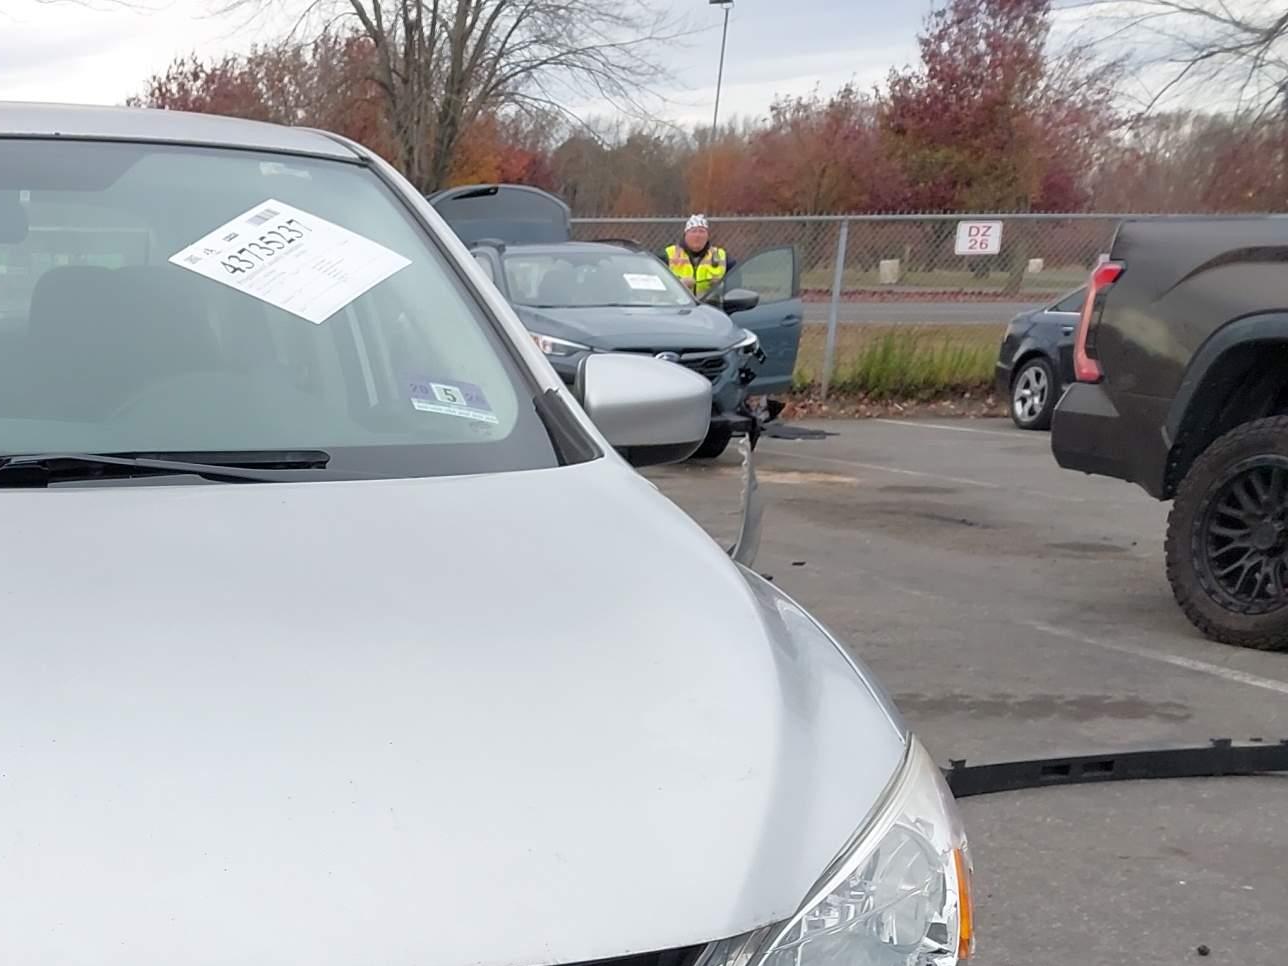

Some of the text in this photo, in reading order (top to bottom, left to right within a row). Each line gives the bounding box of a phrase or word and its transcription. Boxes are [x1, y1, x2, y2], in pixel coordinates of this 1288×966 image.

[968, 225, 993, 237] DZ
[220, 218, 313, 275] 43735237
[968, 238, 989, 250] 26
[442, 387, 458, 403] 5
